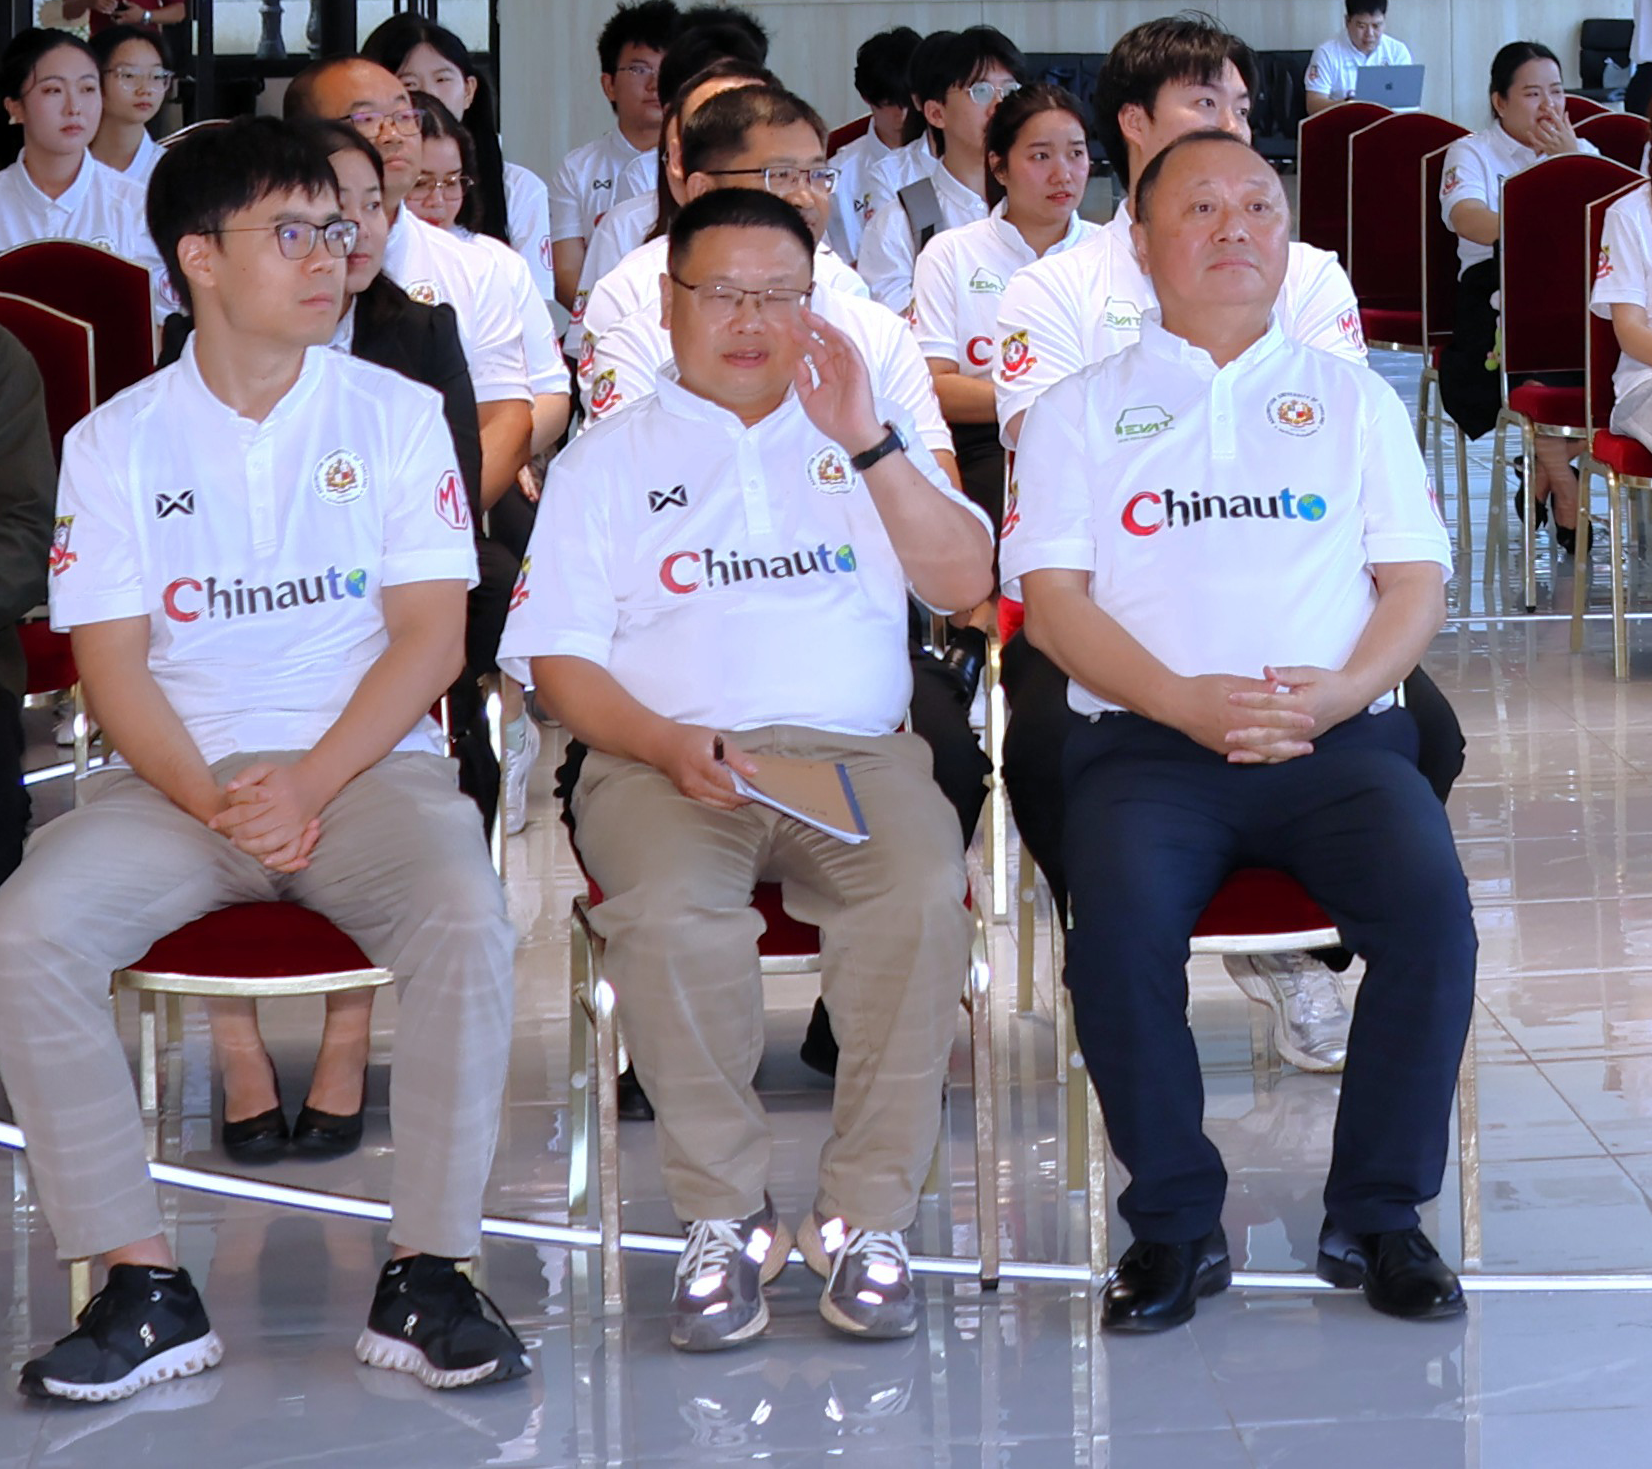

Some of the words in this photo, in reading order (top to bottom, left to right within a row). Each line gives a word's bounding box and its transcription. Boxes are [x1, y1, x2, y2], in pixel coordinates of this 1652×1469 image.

[1121, 487, 1327, 536] Chinauto
[162, 565, 367, 623] Chinauto
[658, 541, 857, 596] Chinauto
